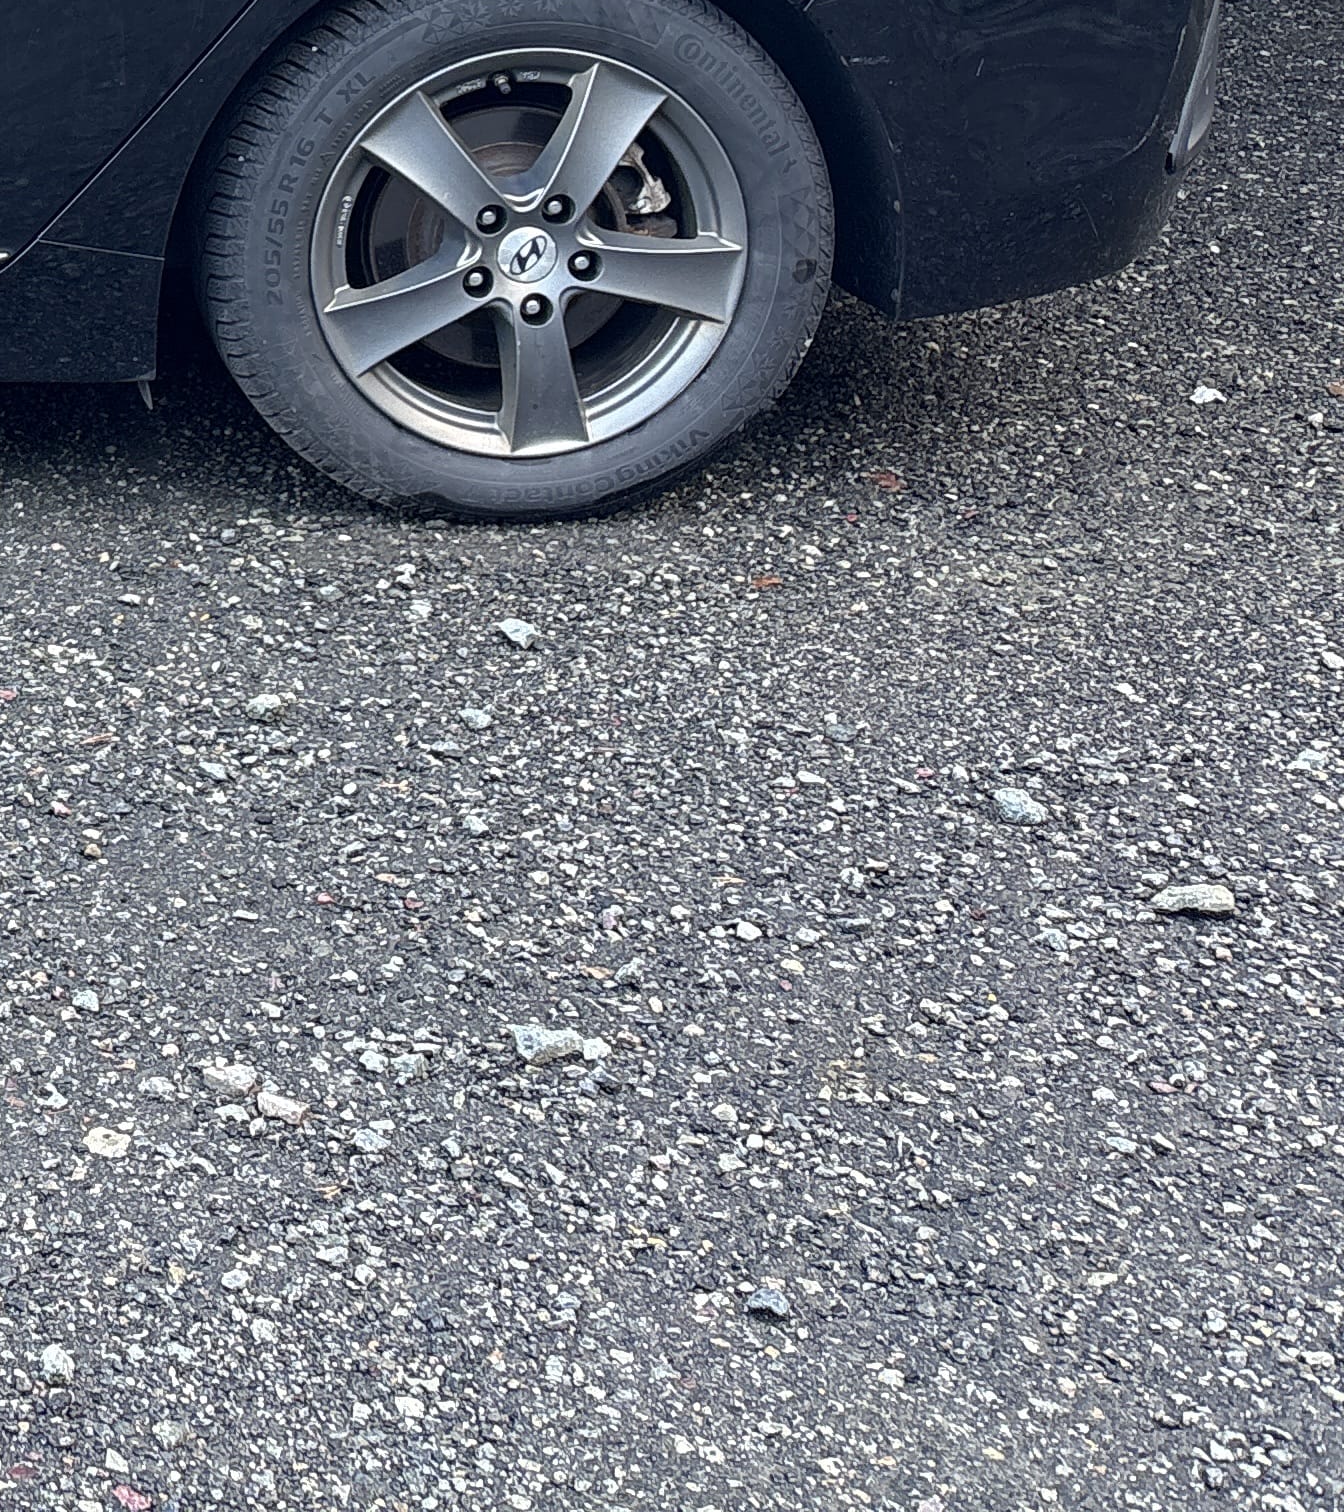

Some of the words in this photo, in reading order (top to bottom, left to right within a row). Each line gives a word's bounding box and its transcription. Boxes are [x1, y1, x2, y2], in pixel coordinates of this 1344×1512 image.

[673, 33, 791, 157] Continental
[264, 198, 289, 306] 205/55
[278, 174, 299, 194] R
[290, 138, 315, 167] 16
[313, 108, 335, 126] T
[336, 71, 377, 104] XL
